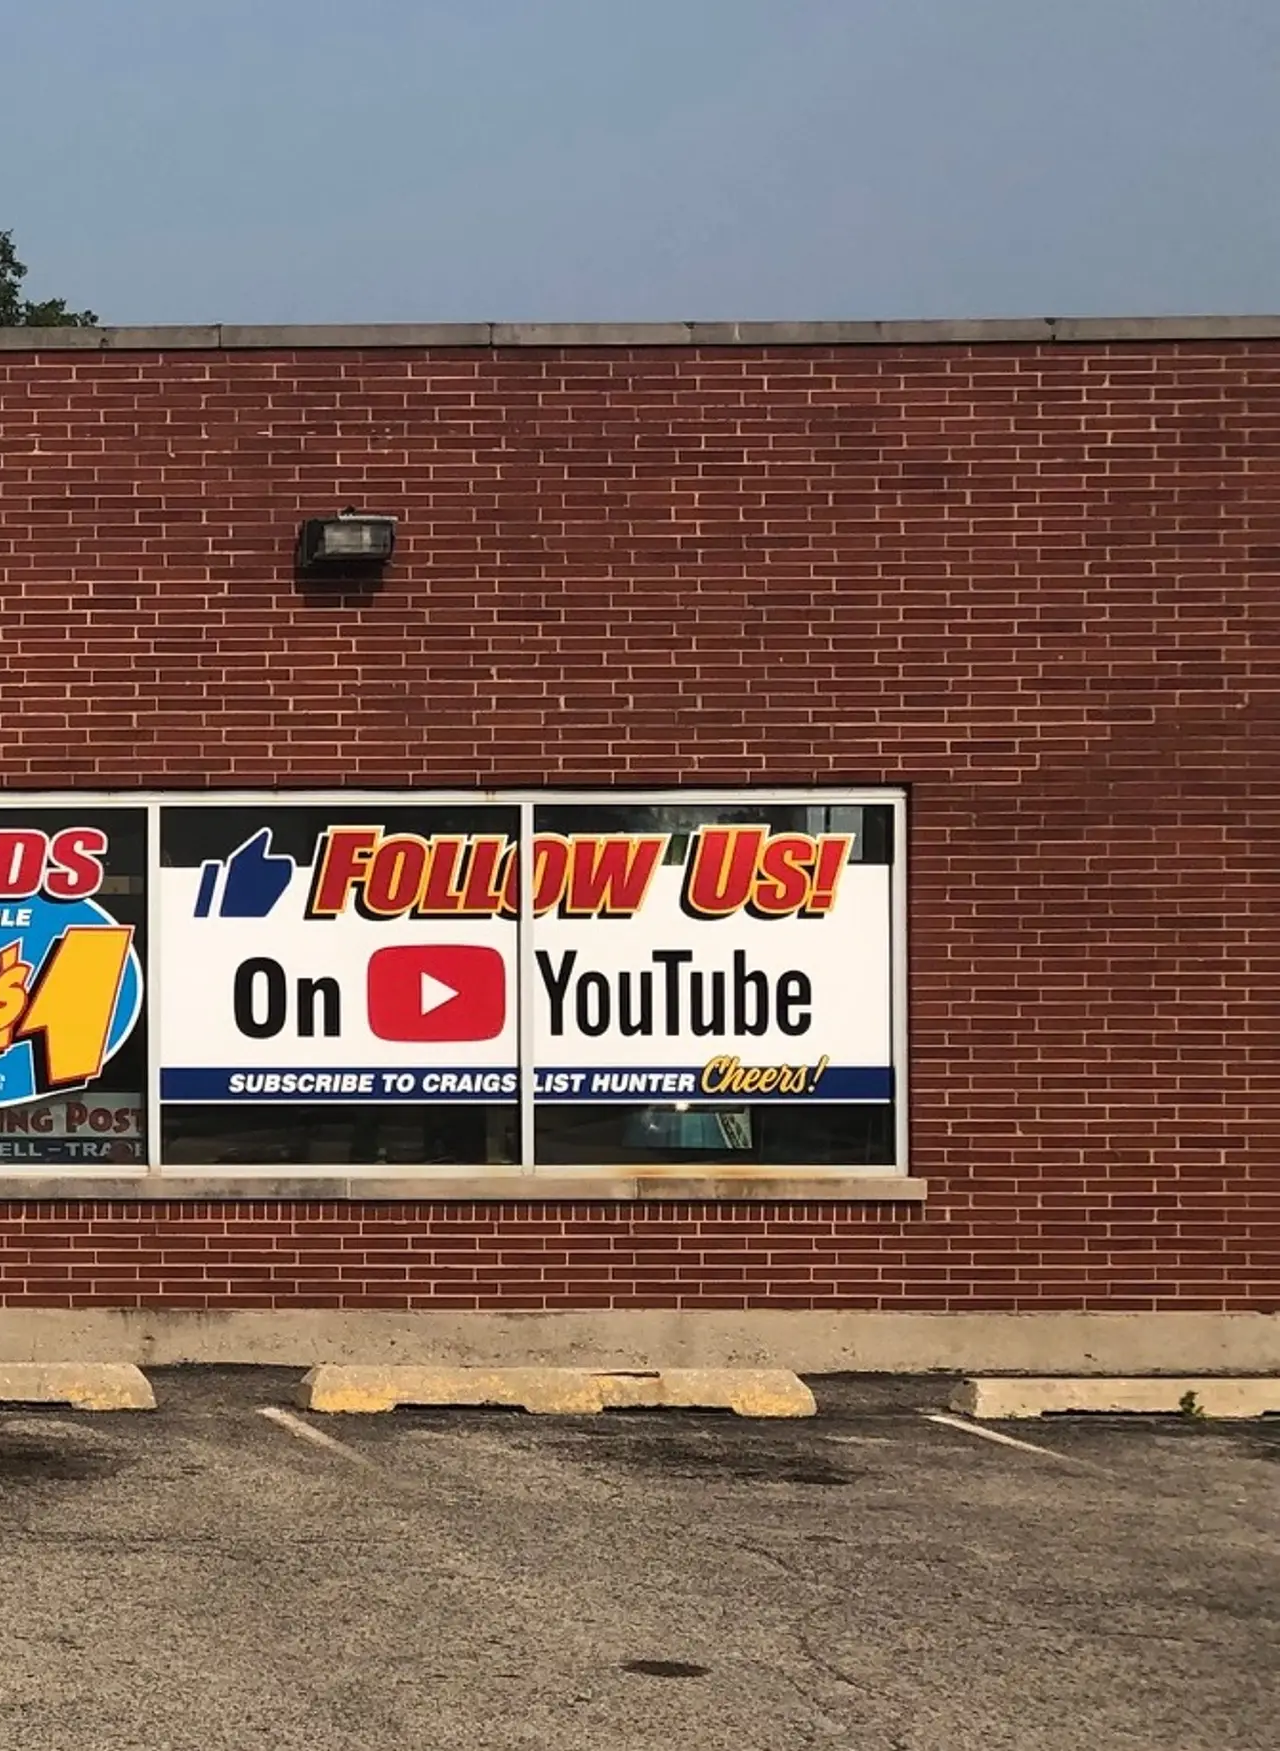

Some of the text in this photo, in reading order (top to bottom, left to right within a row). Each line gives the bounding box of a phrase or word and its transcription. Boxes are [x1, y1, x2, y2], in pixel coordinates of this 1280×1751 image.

[304, 825, 855, 920] FOLLOW US!
[232, 949, 813, 1040] On YouTube
[228, 1073, 375, 1094] SUBSCRIBE
[382, 1073, 416, 1093] TO
[592, 1073, 695, 1093] HUNTER
[700, 1055, 828, 1095] Cheers!
[65, 1142, 144, 1157] TRA
